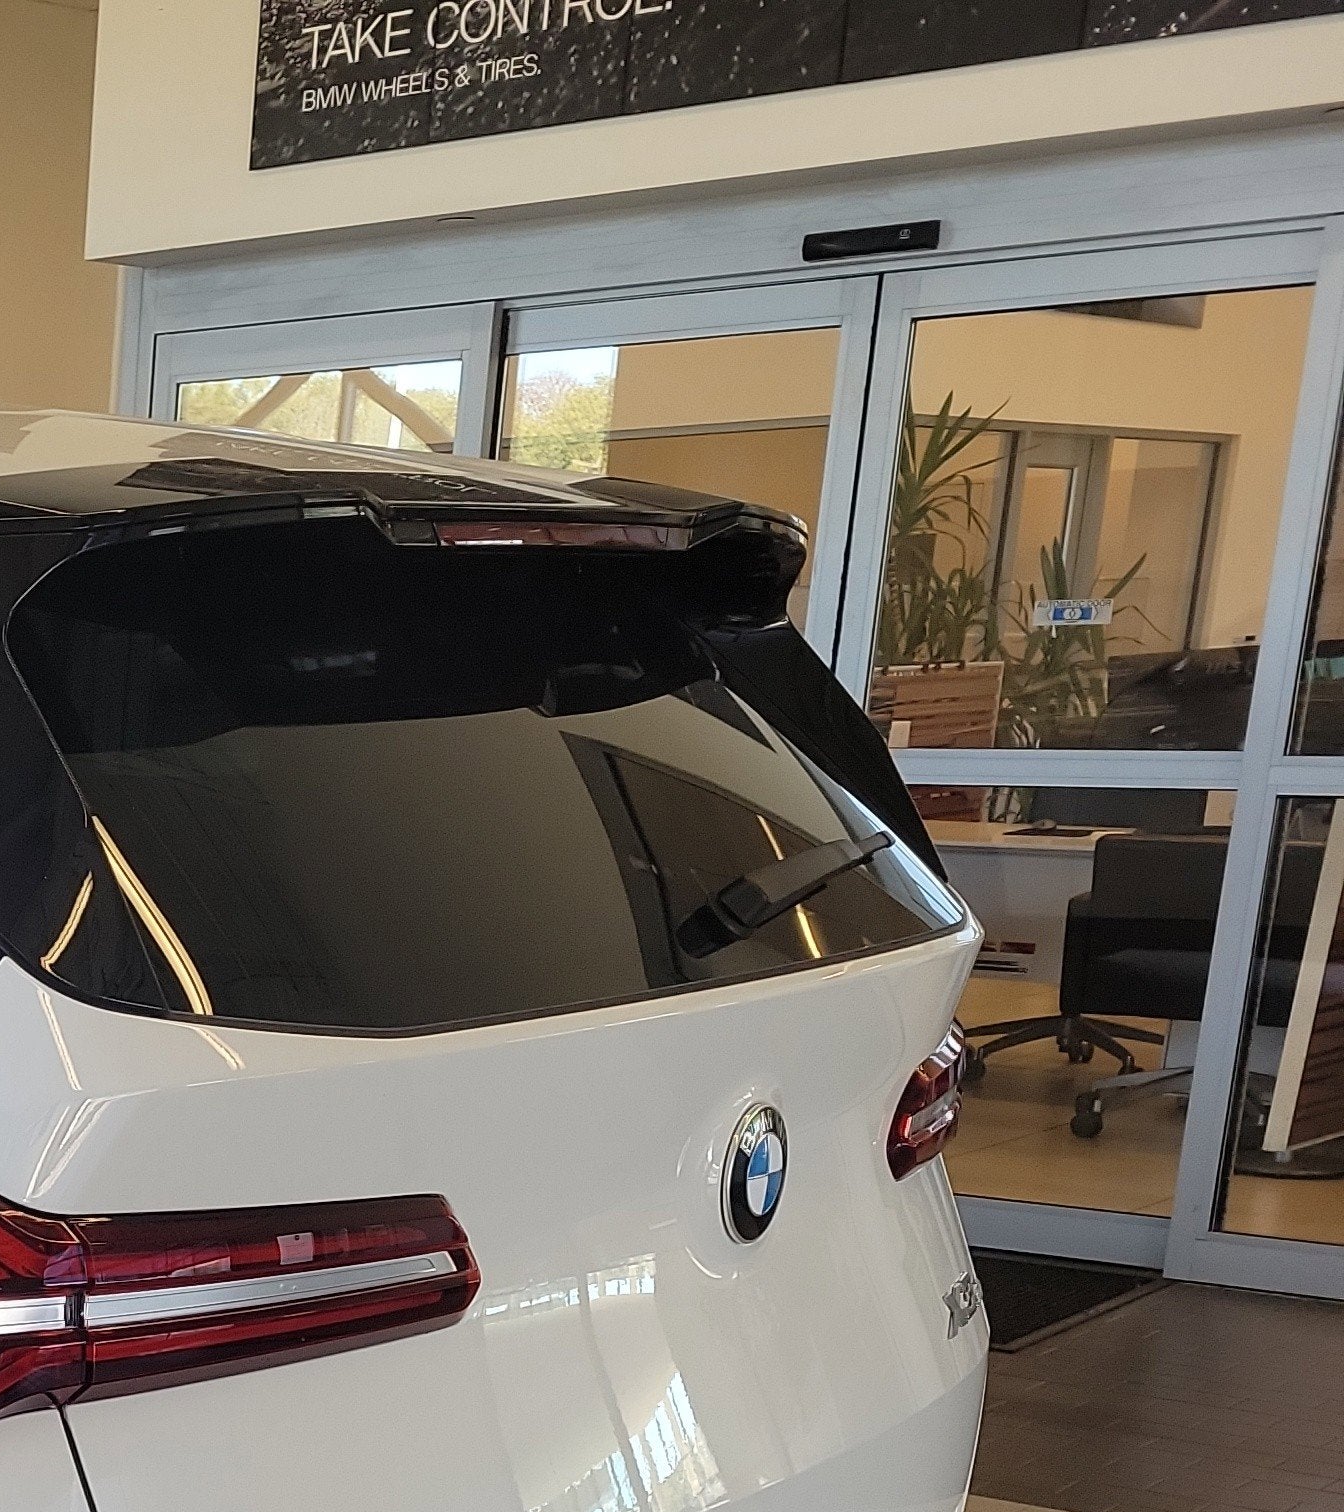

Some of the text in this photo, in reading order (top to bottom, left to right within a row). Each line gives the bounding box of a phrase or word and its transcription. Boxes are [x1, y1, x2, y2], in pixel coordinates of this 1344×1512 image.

[301, 9, 414, 70] TAKE
[301, 53, 542, 113] BMW WHEELS & TIRES.
